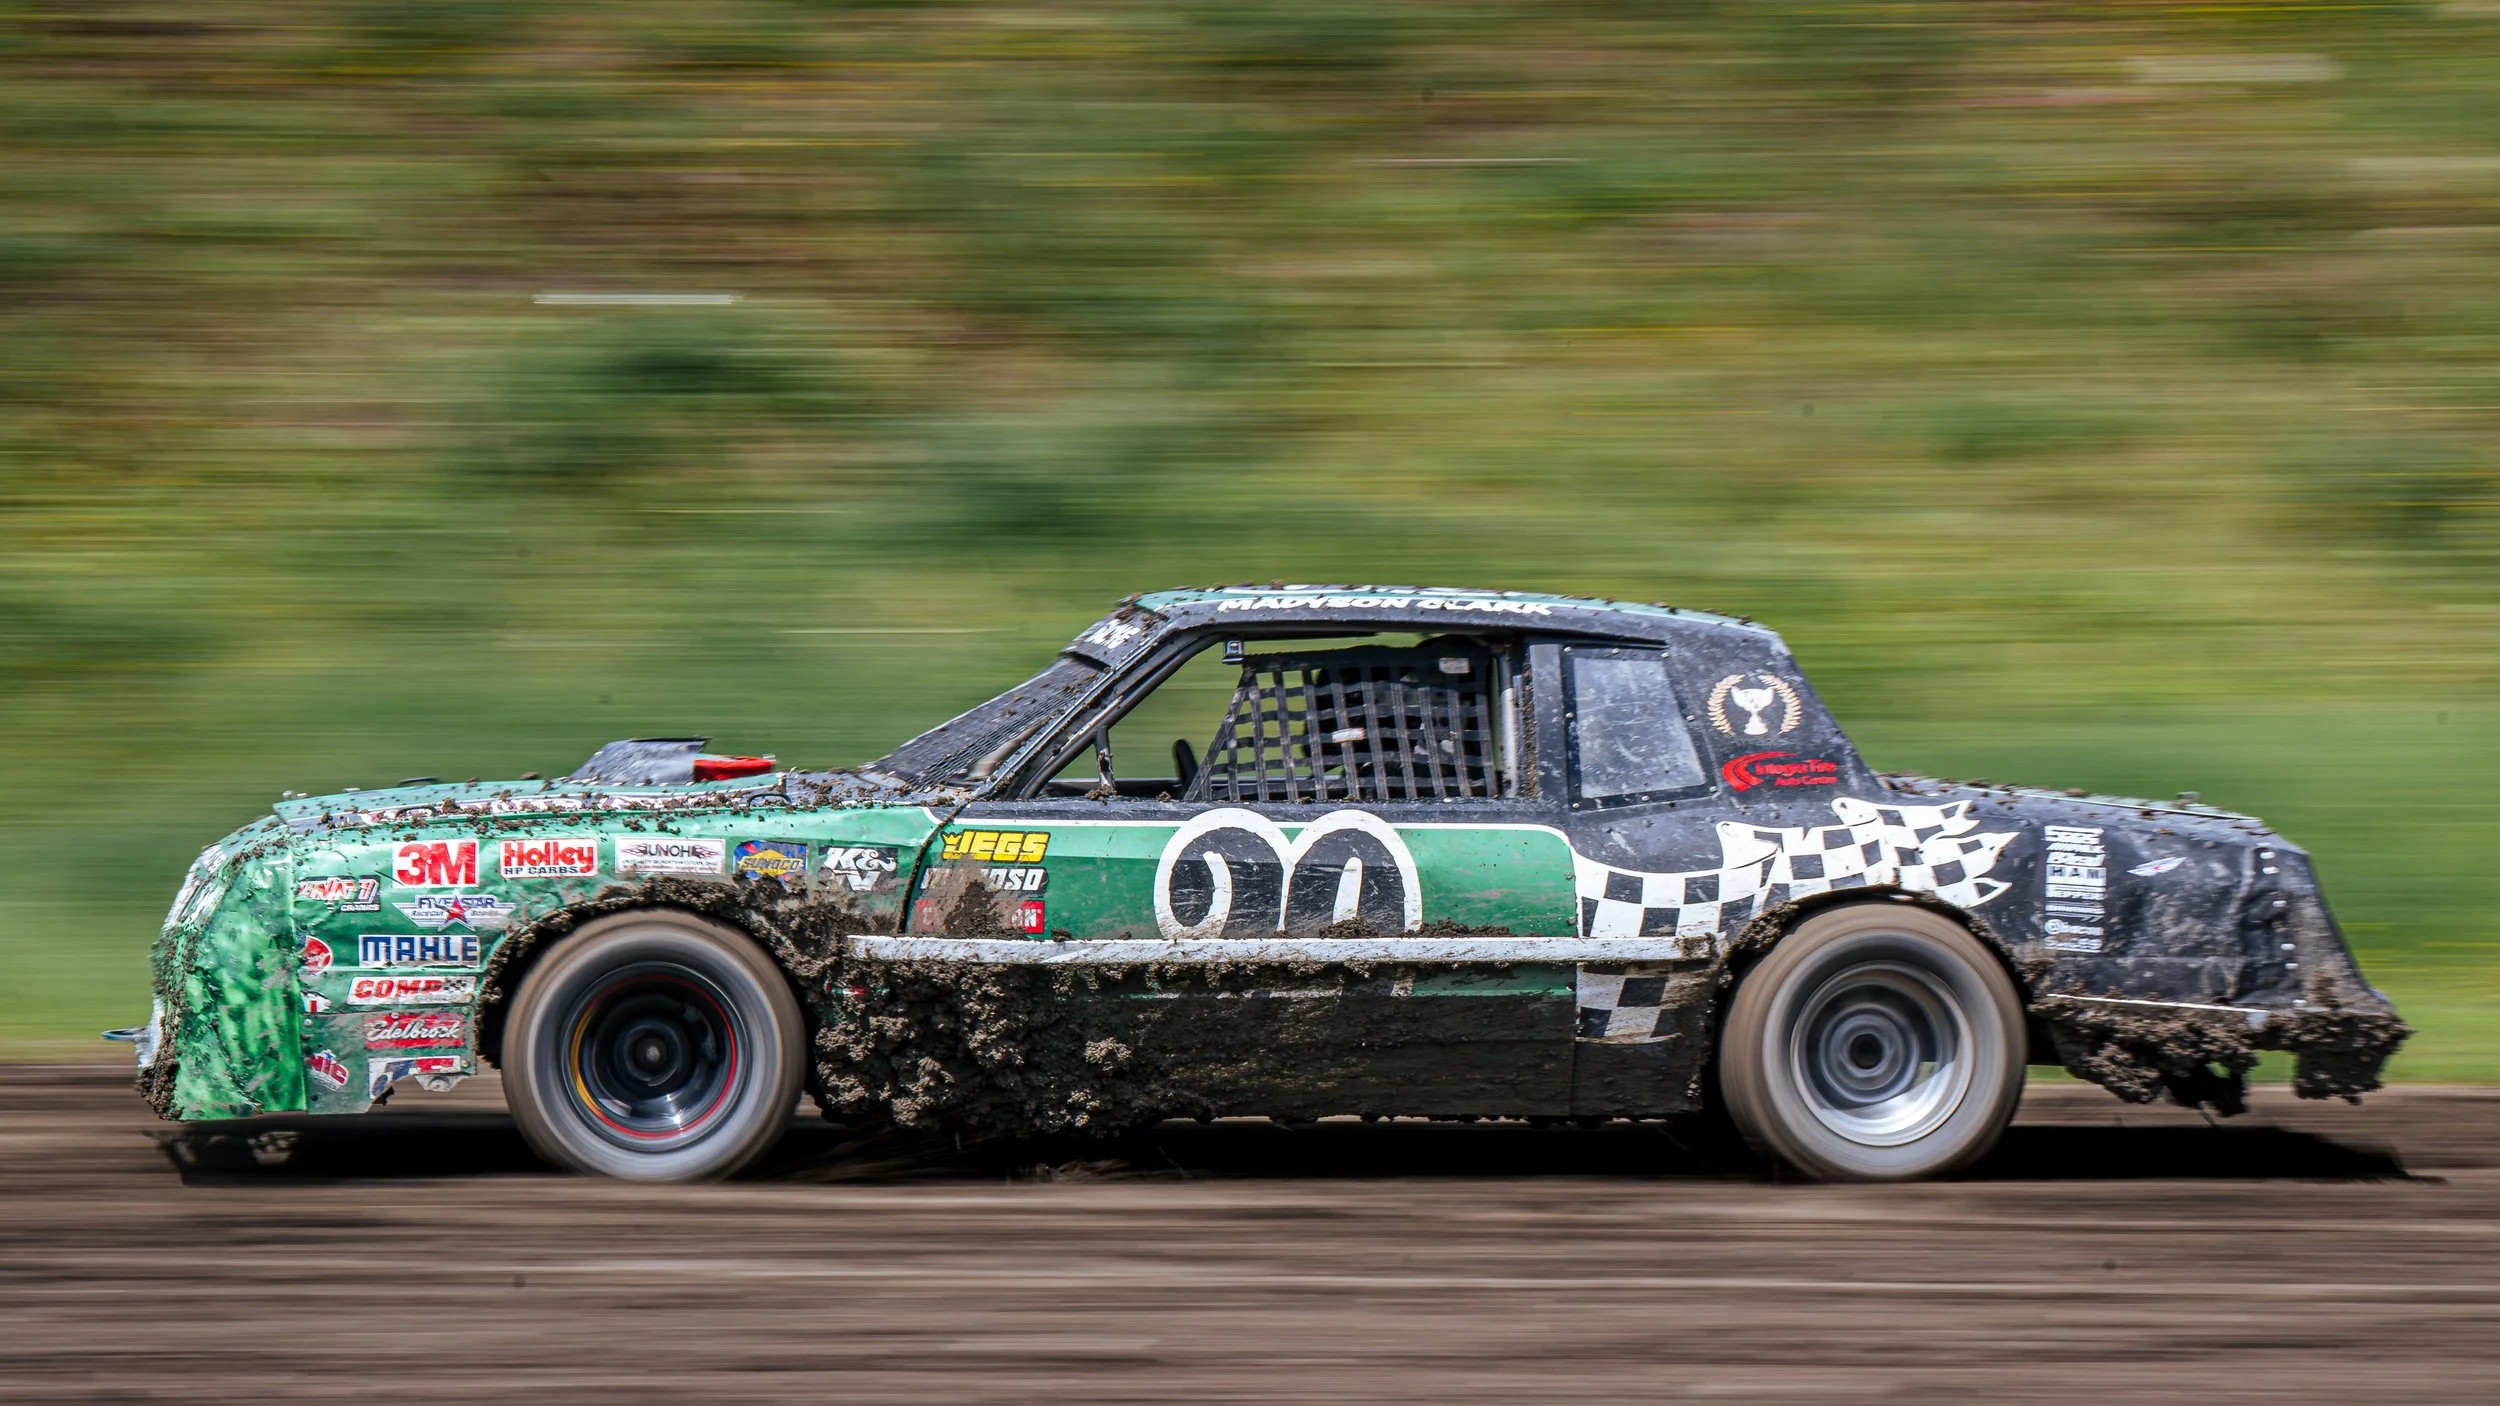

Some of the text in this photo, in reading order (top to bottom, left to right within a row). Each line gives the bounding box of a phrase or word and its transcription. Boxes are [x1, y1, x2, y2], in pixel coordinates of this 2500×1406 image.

[1217, 597, 1411, 611] MADYSON
[943, 831, 1050, 862] JEGS
[397, 842, 477, 885] 3M
[504, 842, 594, 874] Holley
[743, 857, 801, 870] SUNOCO
[504, 866, 579, 875] HP CARBS
[363, 936, 478, 961] MAHLE
[354, 979, 442, 998] COMP
[366, 1020, 461, 1041] Edelbrock
